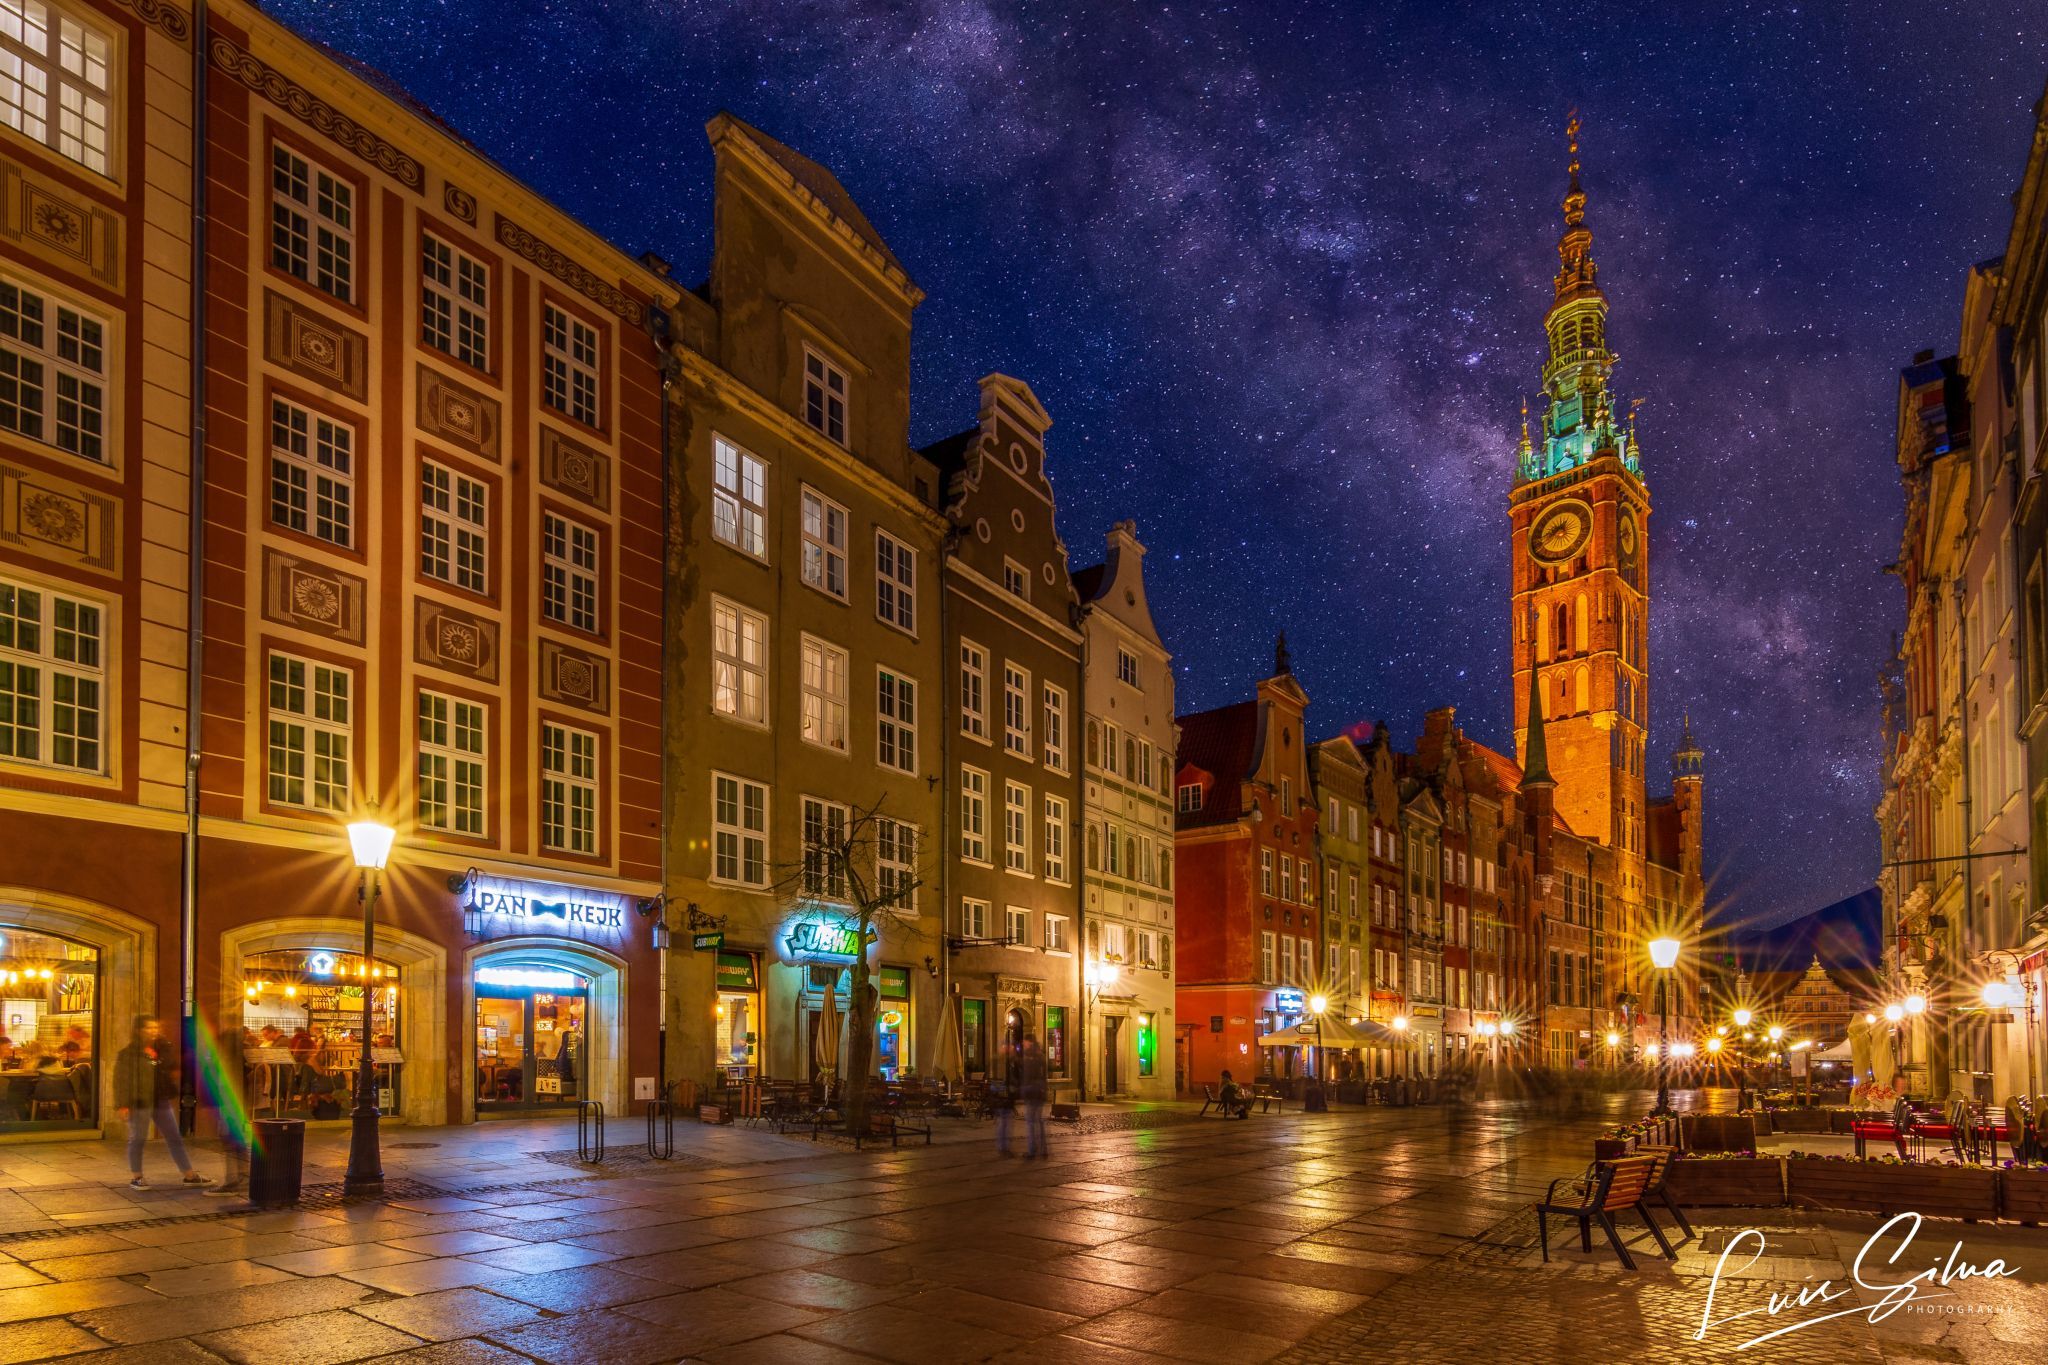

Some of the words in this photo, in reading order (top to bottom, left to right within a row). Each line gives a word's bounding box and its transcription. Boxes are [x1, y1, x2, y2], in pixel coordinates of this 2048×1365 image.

[481, 892, 526, 916] PAN
[570, 903, 622, 927] KEJK
[695, 936, 721, 948] SUBWAY
